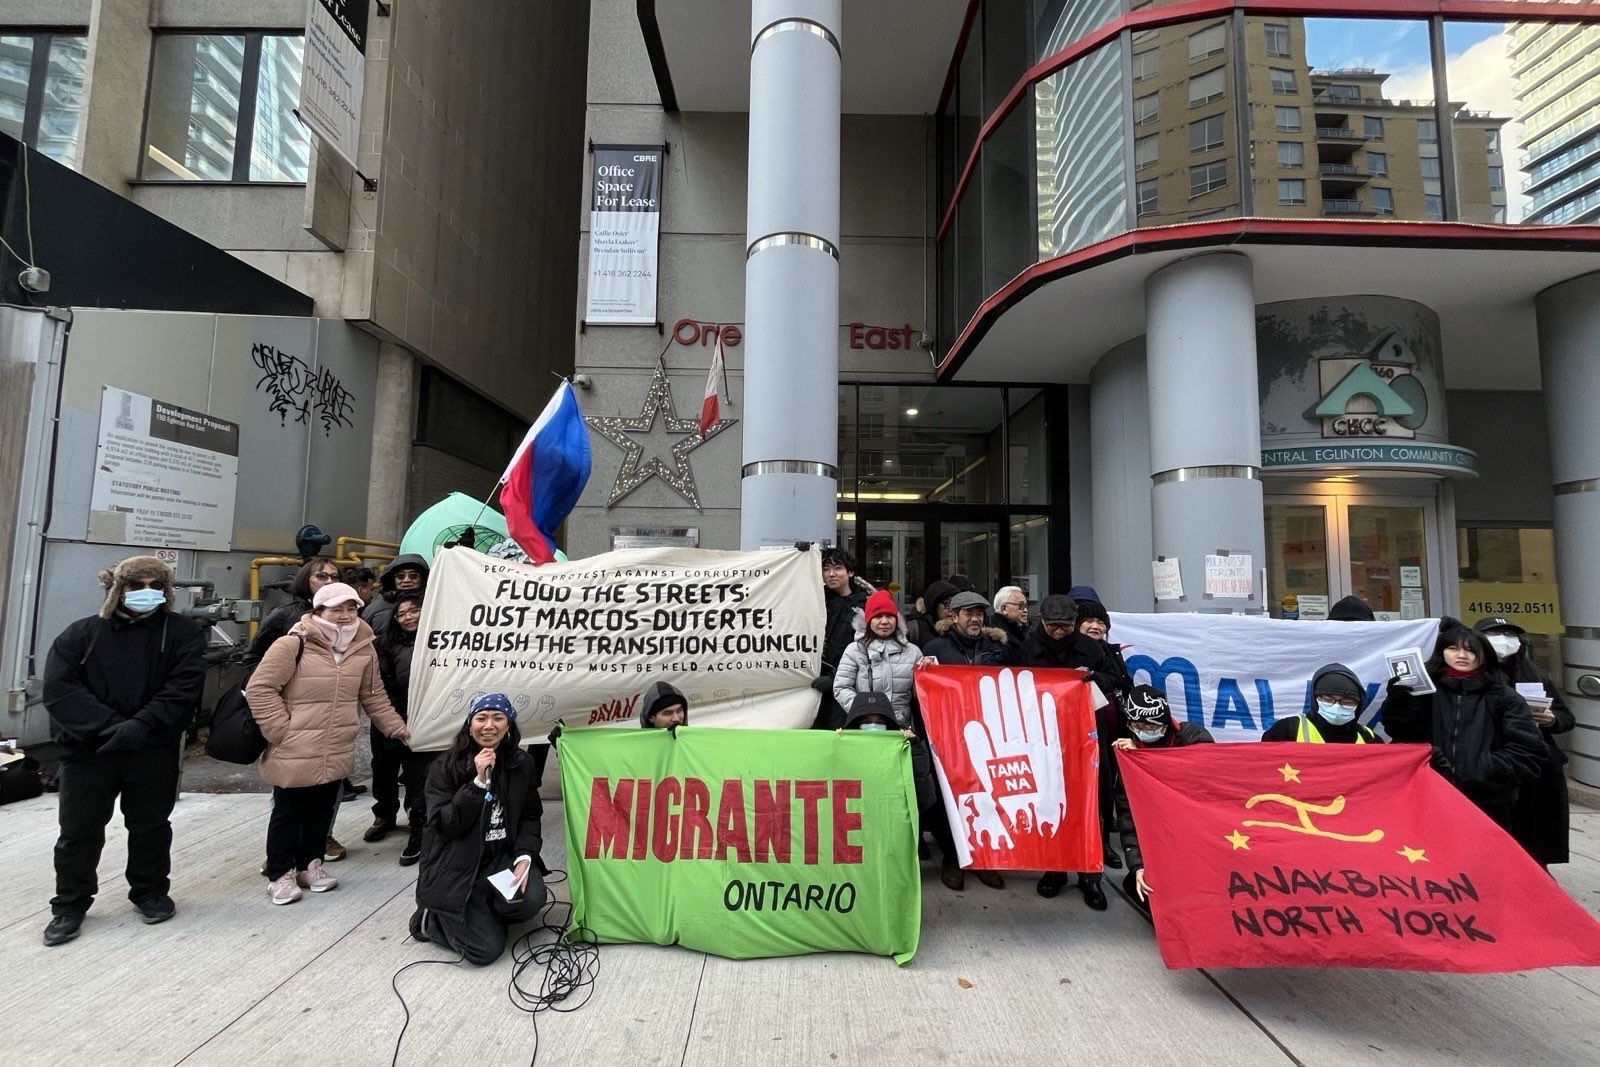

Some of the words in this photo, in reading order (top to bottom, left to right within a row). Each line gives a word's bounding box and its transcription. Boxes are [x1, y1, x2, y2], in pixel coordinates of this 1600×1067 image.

[335, 3, 361, 45] Lease
[598, 165, 635, 177] Office
[597, 180, 634, 194] Space
[596, 195, 618, 207] For
[621, 195, 656, 207] Lease
[673, 318, 742, 346] One
[849, 322, 912, 349] East
[156, 404, 202, 424] Development
[1332, 417, 1387, 435] CECC
[1315, 449, 1383, 461] EGLINTON
[1390, 448, 1452, 463] COMMUNITY
[551, 569, 607, 582] PROTEST
[614, 569, 675, 578] AGAINST
[685, 569, 771, 578] CORRUPTION
[495, 579, 572, 603] FLOOD
[581, 583, 629, 604] THE
[635, 583, 750, 604] STREETS:
[470, 604, 531, 629] OUST
[535, 608, 773, 632] MARCOS-DUTERTE!
[1468, 602, 1554, 614] 416.392.0511
[427, 630, 530, 653] ESTABLISH
[535, 634, 578, 655] THE
[583, 635, 717, 656] TRANSITION
[722, 633, 818, 654] COUNCIL!
[429, 658, 449, 668] ALL
[456, 658, 496, 669] THOSE
[503, 660, 574, 672] INVOLVED
[589, 662, 627, 673] MUST
[636, 662, 652, 673] BE
[662, 661, 698, 672] HELD
[707, 659, 813, 672] ACCOUNTABLE!
[587, 693, 641, 725] BAYAN
[988, 760, 1033, 779] TAMA
[1005, 777, 1032, 792] NA
[584, 775, 864, 865] MIGRANTE
[1228, 866, 1480, 905] ANAKBAYAN
[722, 879, 857, 914] ONTARIO
[1231, 906, 1364, 937] NORTH
[1378, 906, 1497, 943] YORK
